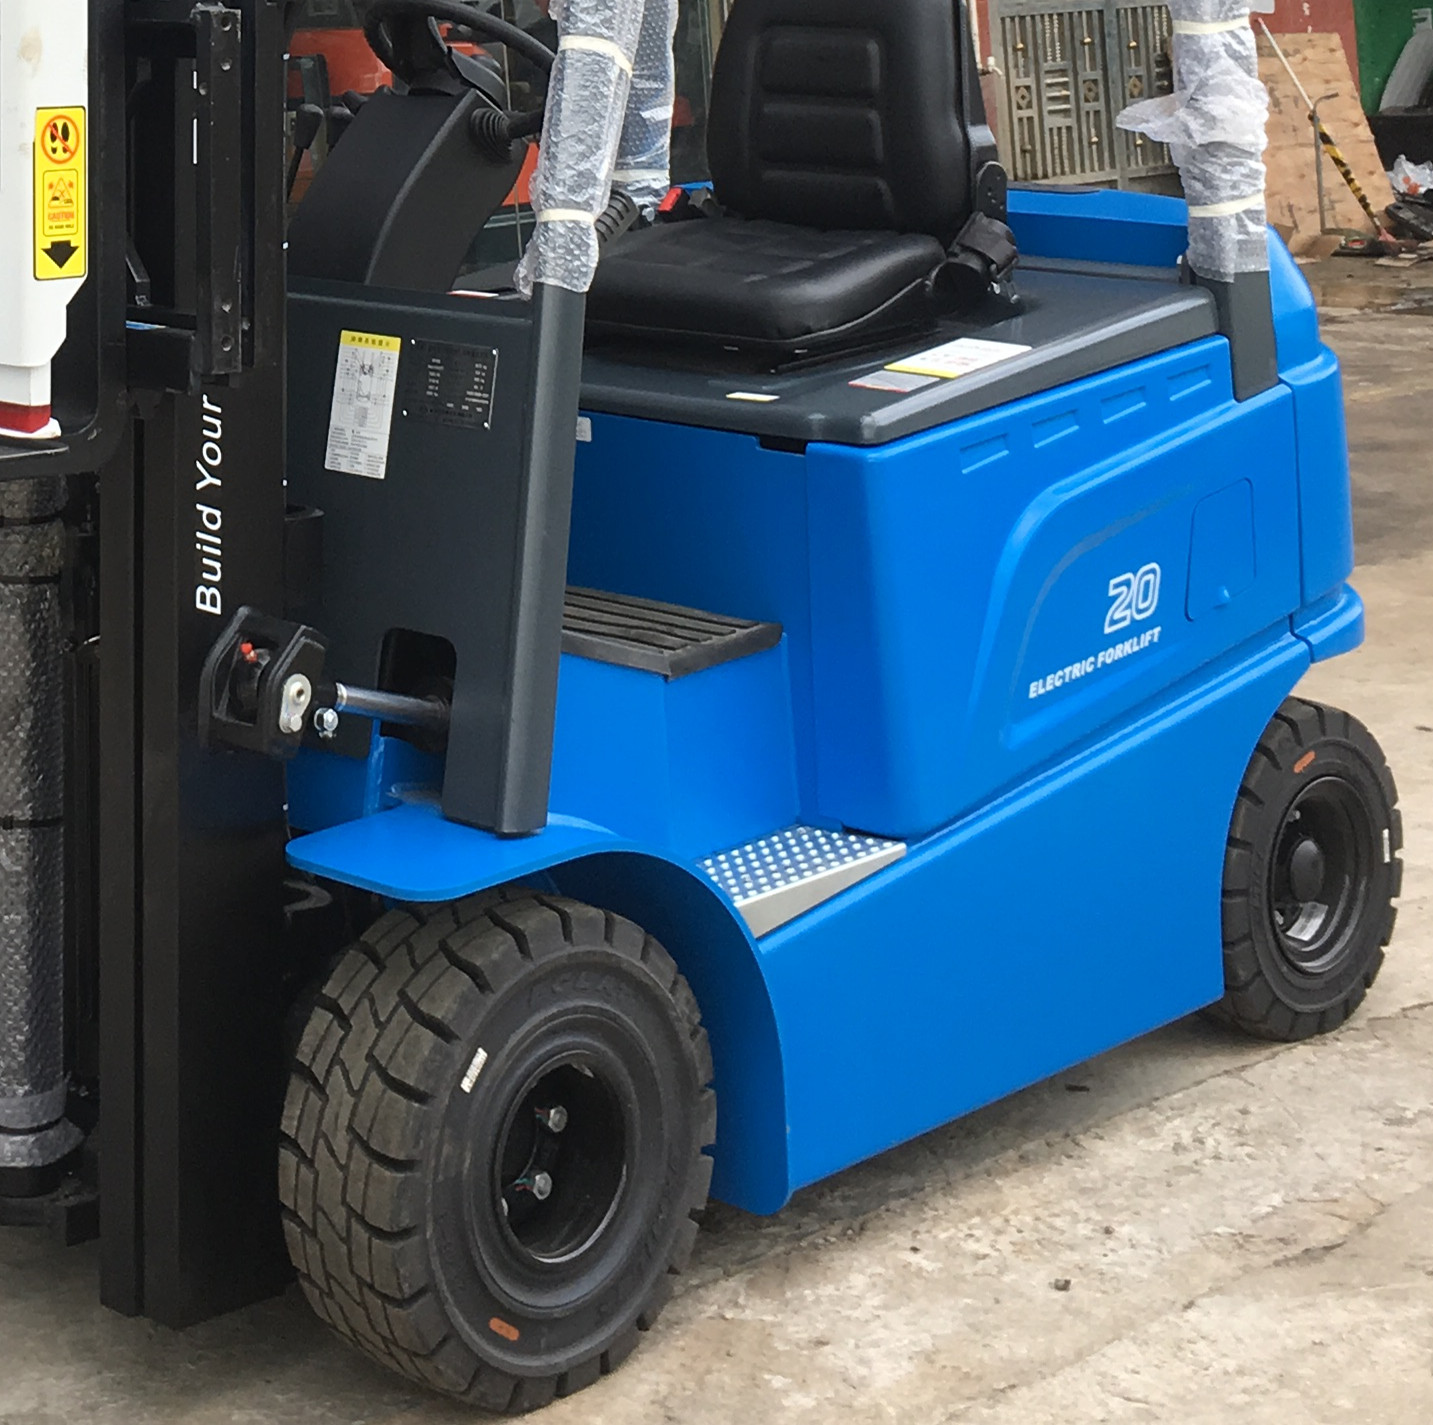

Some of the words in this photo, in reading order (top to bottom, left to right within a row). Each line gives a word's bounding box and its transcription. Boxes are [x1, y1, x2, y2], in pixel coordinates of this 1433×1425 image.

[195, 394, 222, 490] Your
[195, 503, 222, 615] Build
[1103, 562, 1161, 635] 20
[1028, 656, 1095, 699] ELECTRIC
[1096, 625, 1162, 668] FORKLIFT
